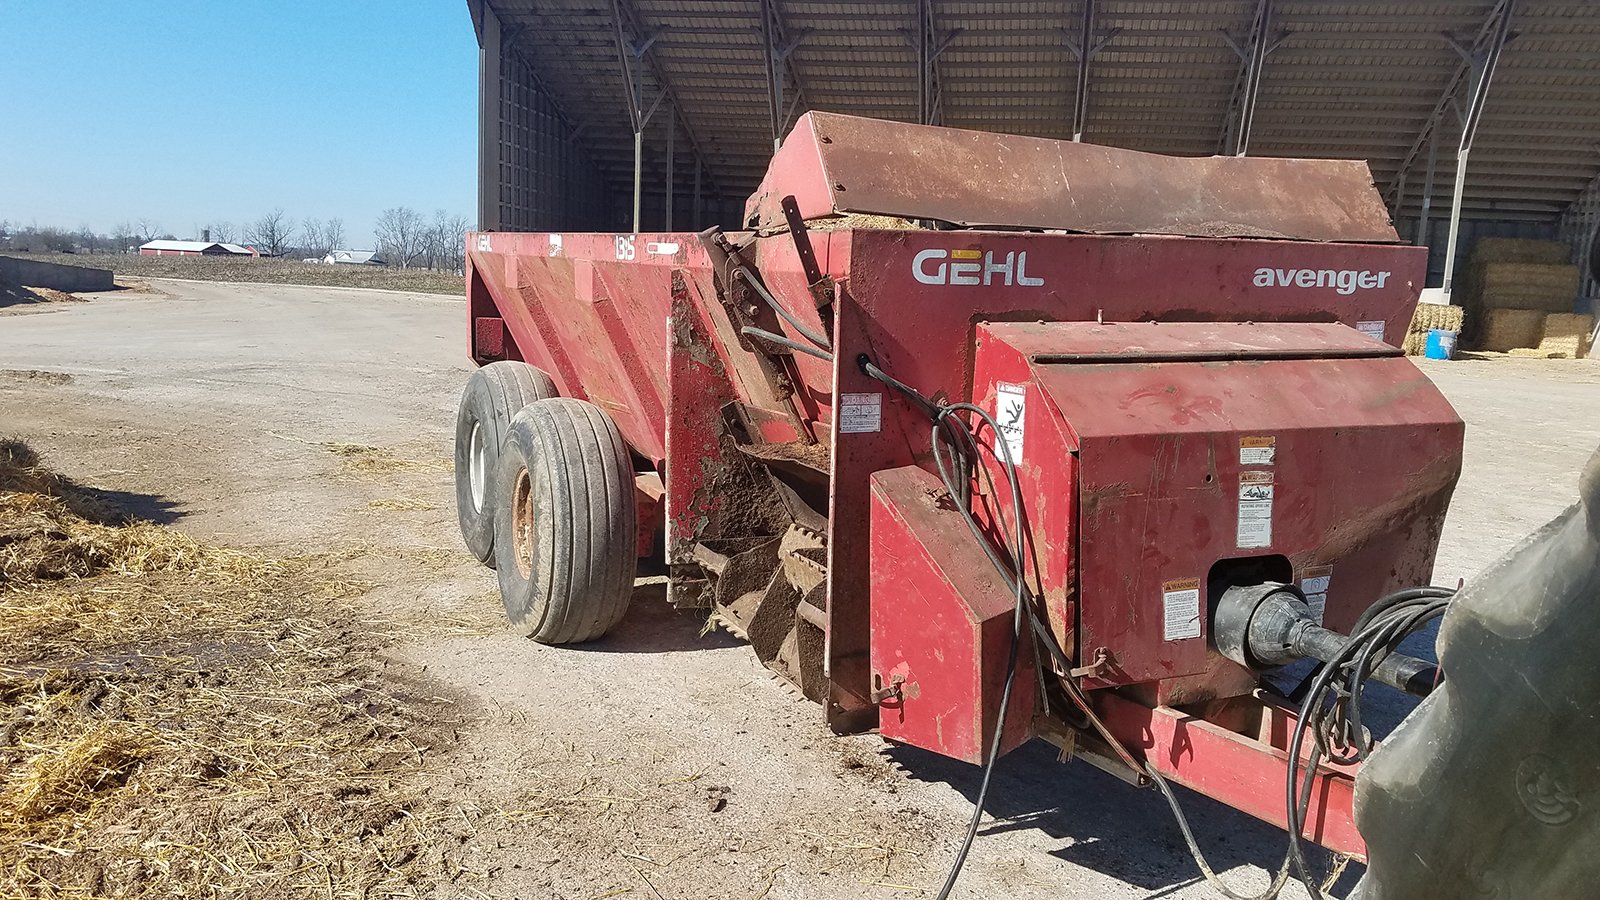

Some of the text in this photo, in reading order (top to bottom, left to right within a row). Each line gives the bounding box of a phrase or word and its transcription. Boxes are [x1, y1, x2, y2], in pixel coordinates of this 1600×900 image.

[911, 249, 1045, 286] GEHL
[1252, 267, 1391, 295] avenger
[1171, 580, 1199, 590] WARNING
